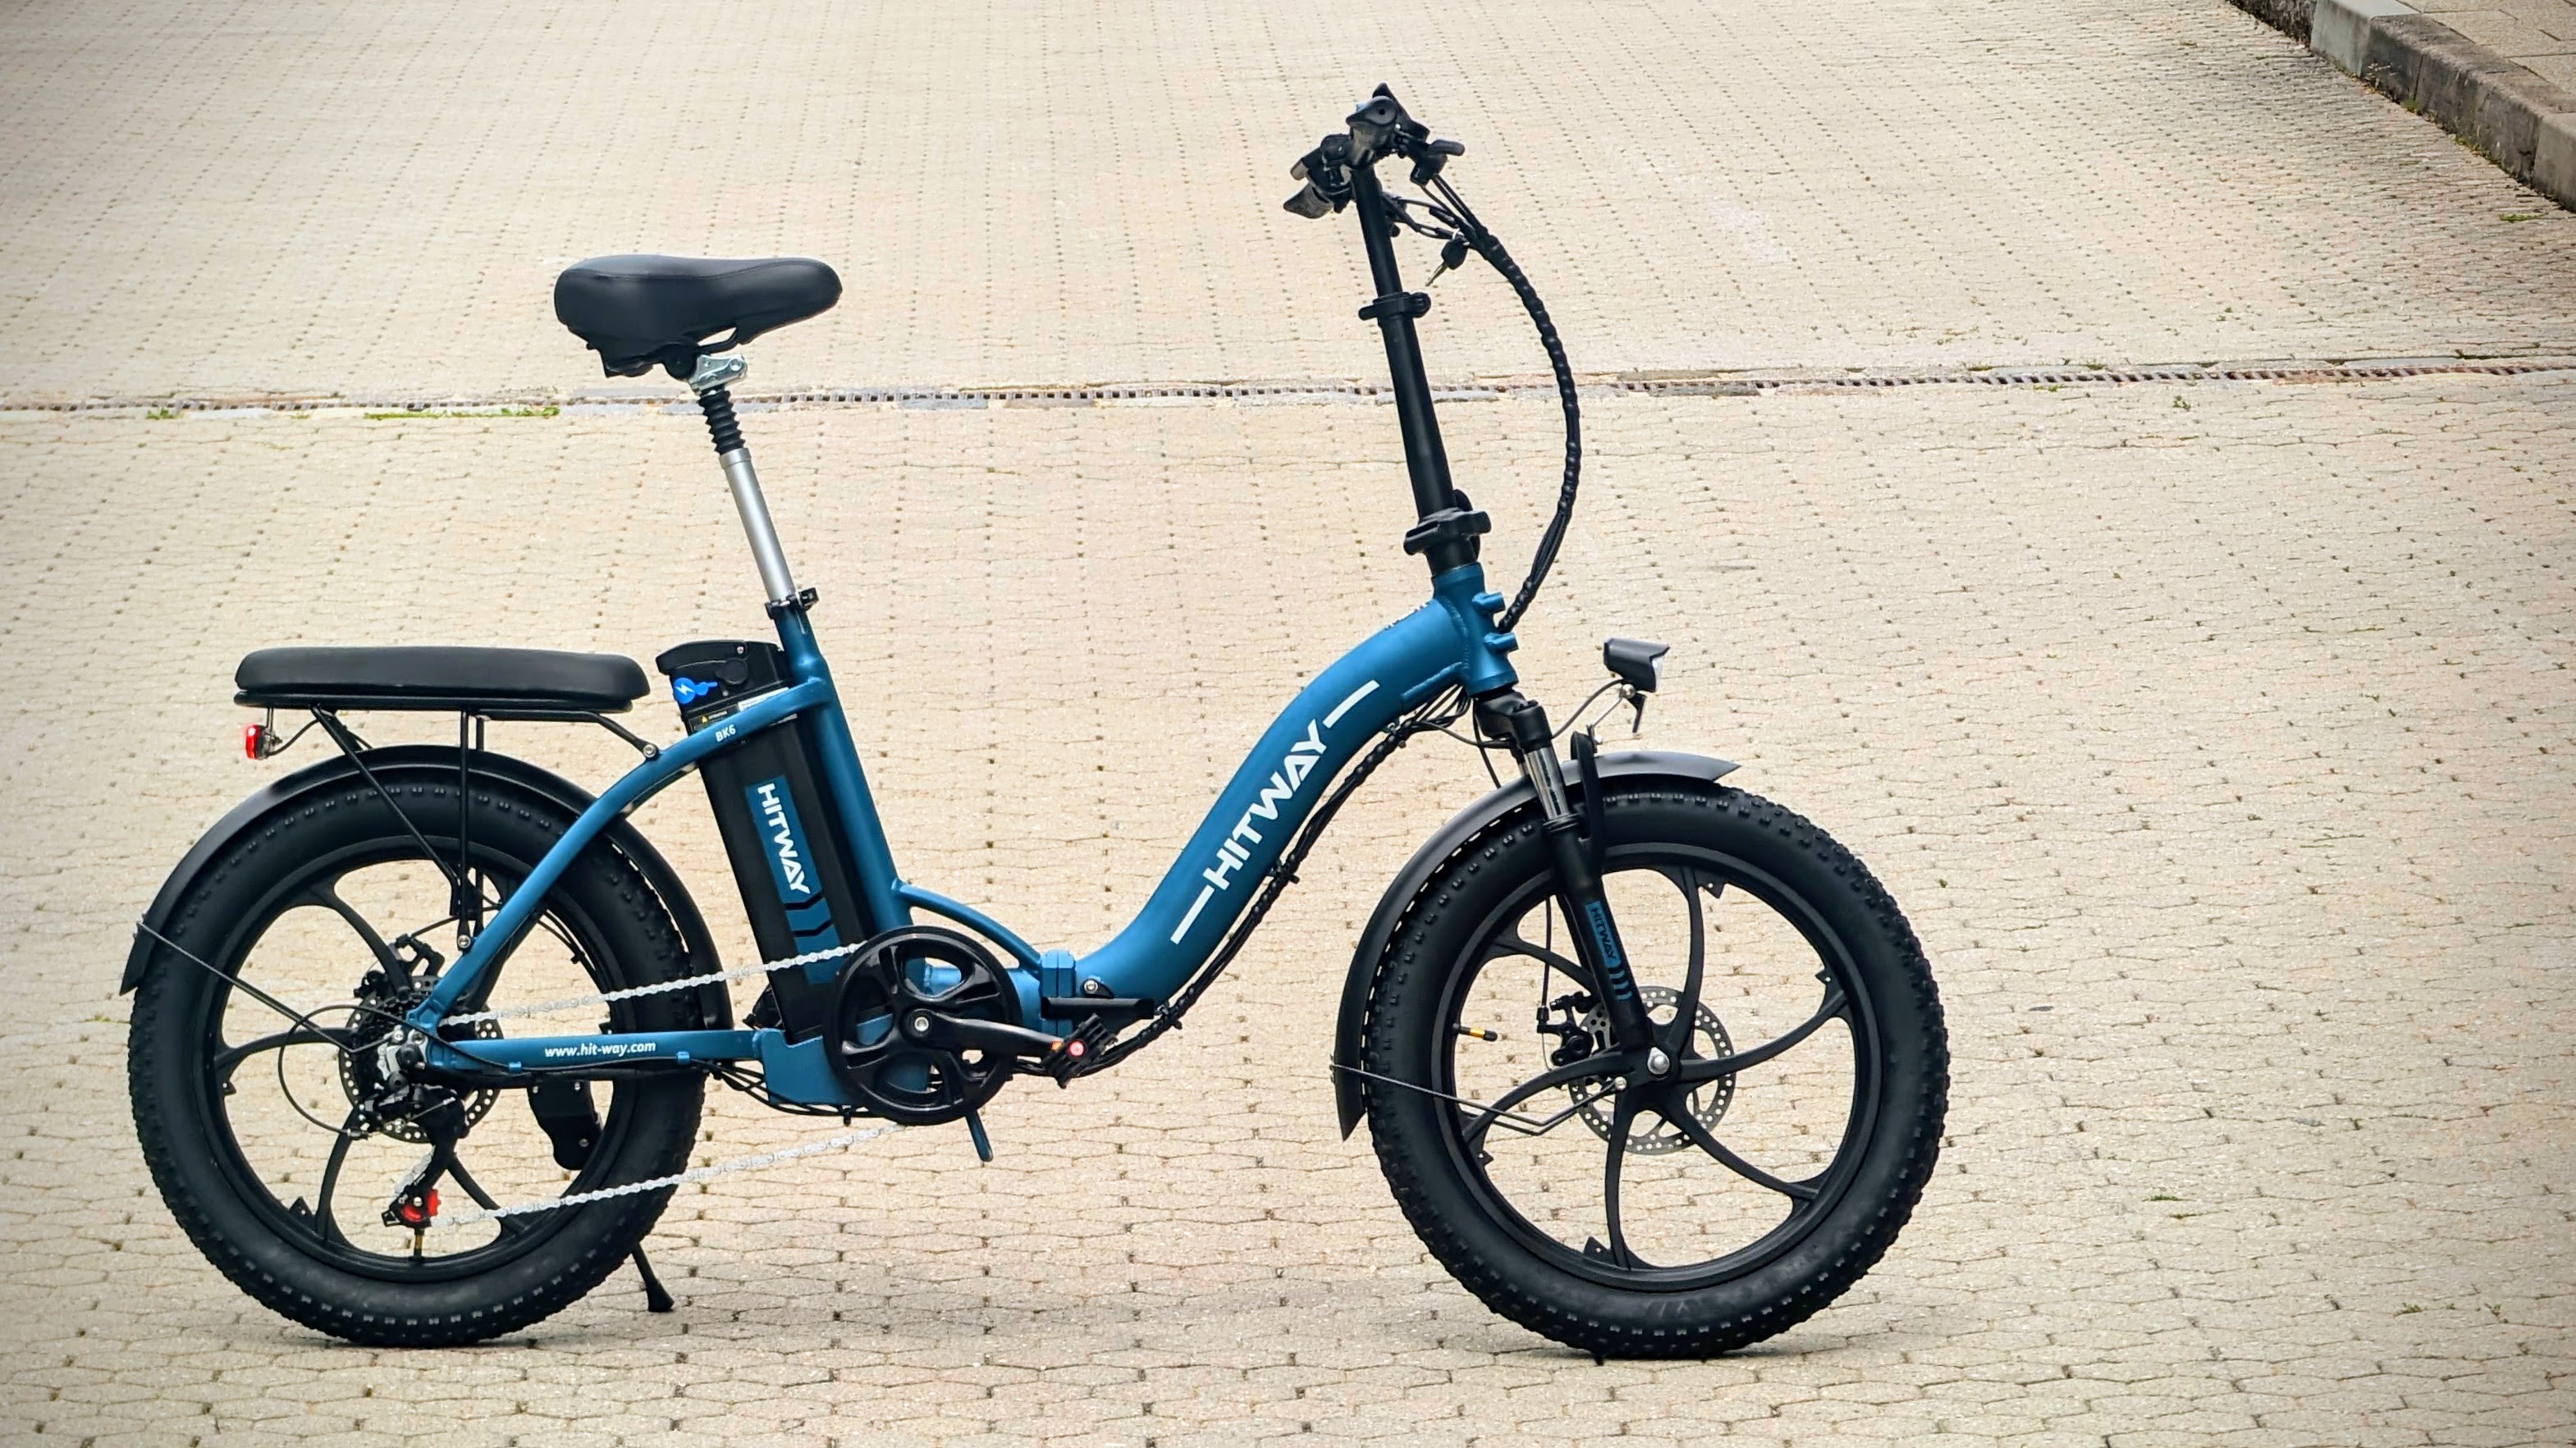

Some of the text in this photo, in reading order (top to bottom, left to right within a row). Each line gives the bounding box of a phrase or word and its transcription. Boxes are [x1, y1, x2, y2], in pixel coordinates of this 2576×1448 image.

[715, 724, 736, 742] BK6
[1202, 718, 1327, 891] HITWAY
[757, 783, 811, 894] HITWAY
[1591, 907, 1617, 959] HITWAY
[545, 1042, 657, 1057] www.hit-way.com
